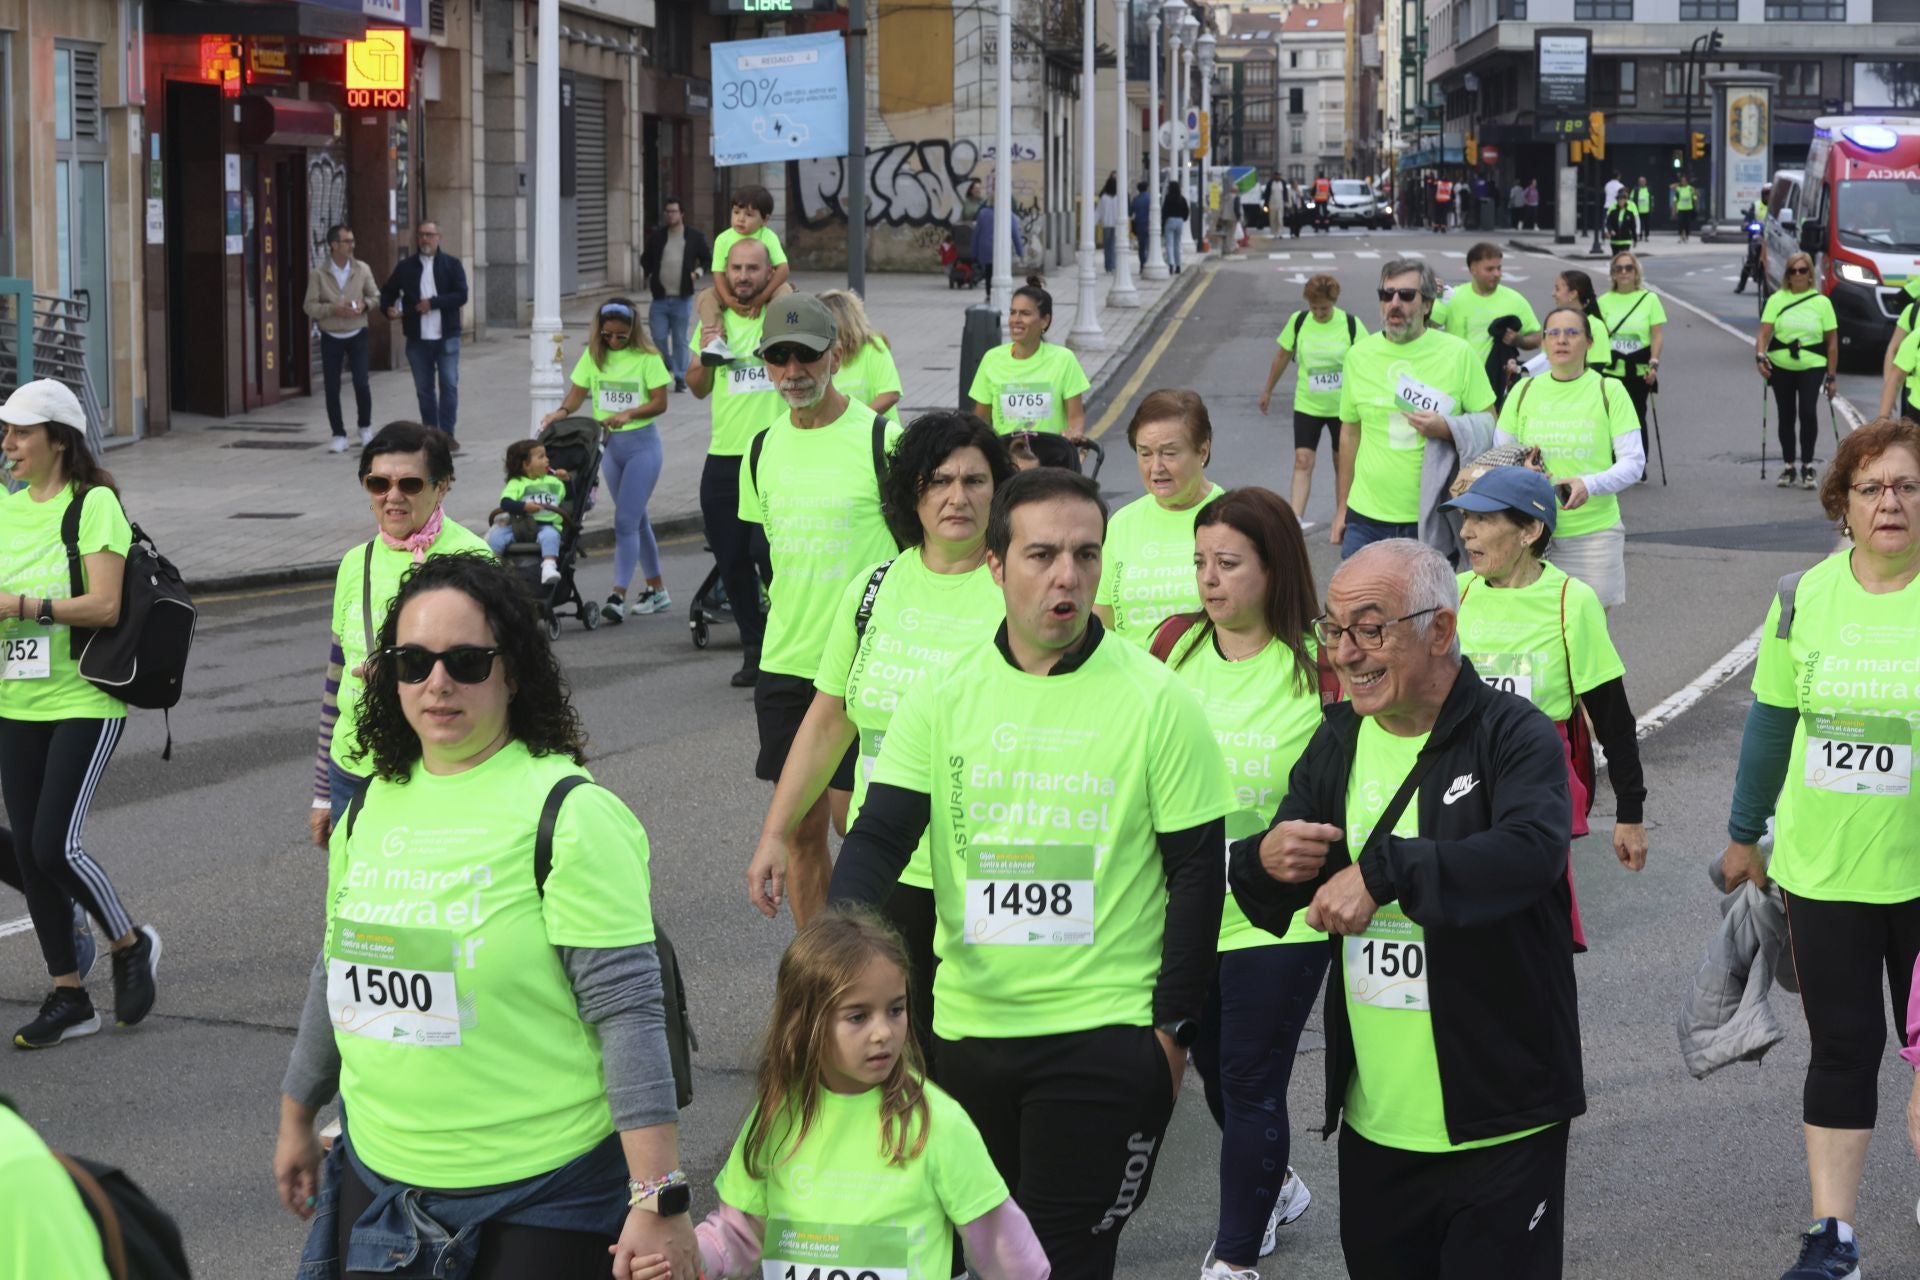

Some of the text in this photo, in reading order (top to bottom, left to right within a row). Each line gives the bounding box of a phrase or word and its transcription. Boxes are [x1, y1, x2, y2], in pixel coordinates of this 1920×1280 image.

[744, 0, 792, 11] LIBRE
[760, 55, 795, 65] REGALO
[348, 90, 369, 107] 00
[721, 77, 783, 110] 30%
[264, 177, 274, 370] TABACOS
[1615, 340, 1638, 350] 0165
[734, 367, 766, 383] 0764
[1314, 373, 1340, 385] 1420
[604, 391, 632, 404] 1859
[1008, 394, 1044, 407] 0765
[1126, 565, 1197, 579] En mar
[1113, 561, 1126, 631] ASTURIAS
[877, 633, 951, 663] En mar
[848, 625, 877, 709] ASTURIAS
[1823, 655, 1850, 672] En
[1816, 678, 1909, 700] contra
[1213, 729, 1278, 749] archa
[1243, 754, 1272, 777] el
[1822, 740, 1894, 772] 1270
[970, 763, 1116, 797] En marcha
[1449, 772, 1473, 794] NIKE
[949, 755, 967, 860] ASTURIAS
[969, 797, 1109, 832] contra el
[349, 861, 378, 888] En
[445, 892, 484, 925] el
[983, 882, 1072, 916] 1498
[1387, 920, 1412, 928] cáncer
[1362, 940, 1423, 979] 150
[345, 965, 433, 1013] 1500
[1255, 1096, 1279, 1198] MODE
